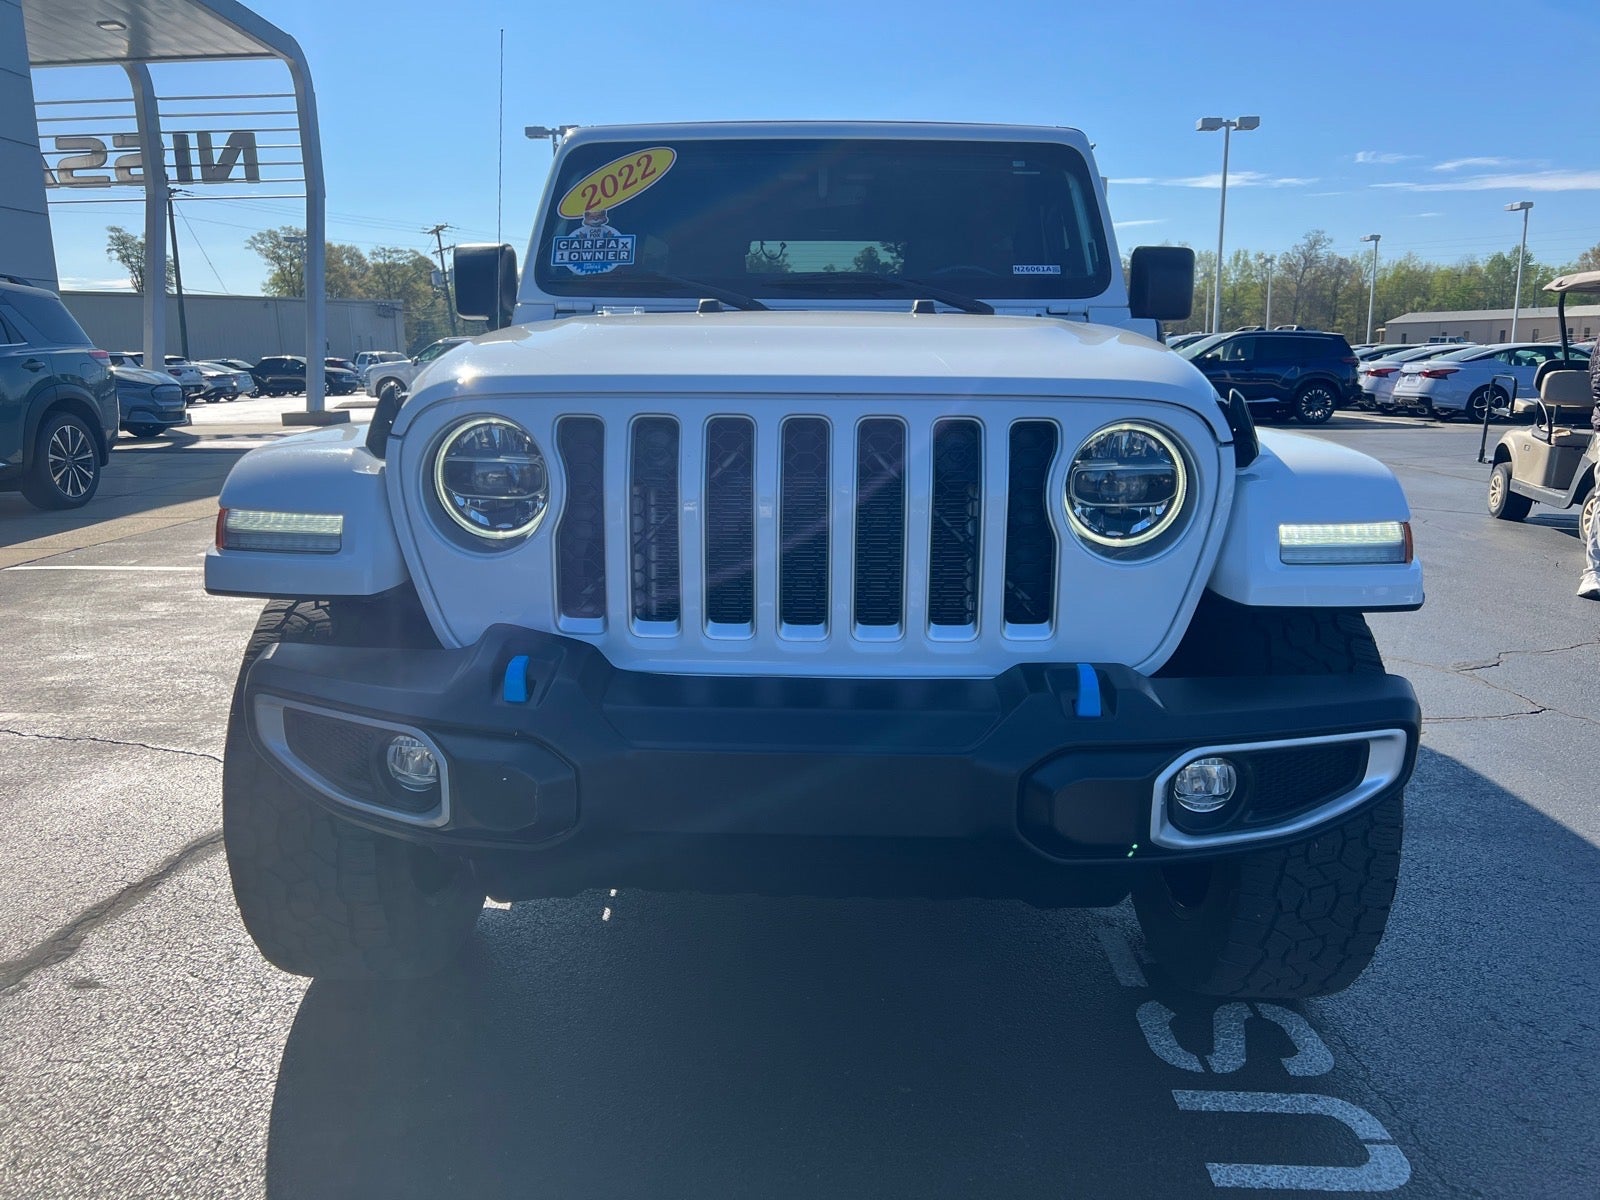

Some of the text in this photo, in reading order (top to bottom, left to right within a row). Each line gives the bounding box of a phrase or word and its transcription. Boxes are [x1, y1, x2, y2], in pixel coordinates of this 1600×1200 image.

[581, 154, 656, 211] 2022
[560, 240, 629, 249] CARFAX
[559, 251, 628, 260] 1 OWNER
